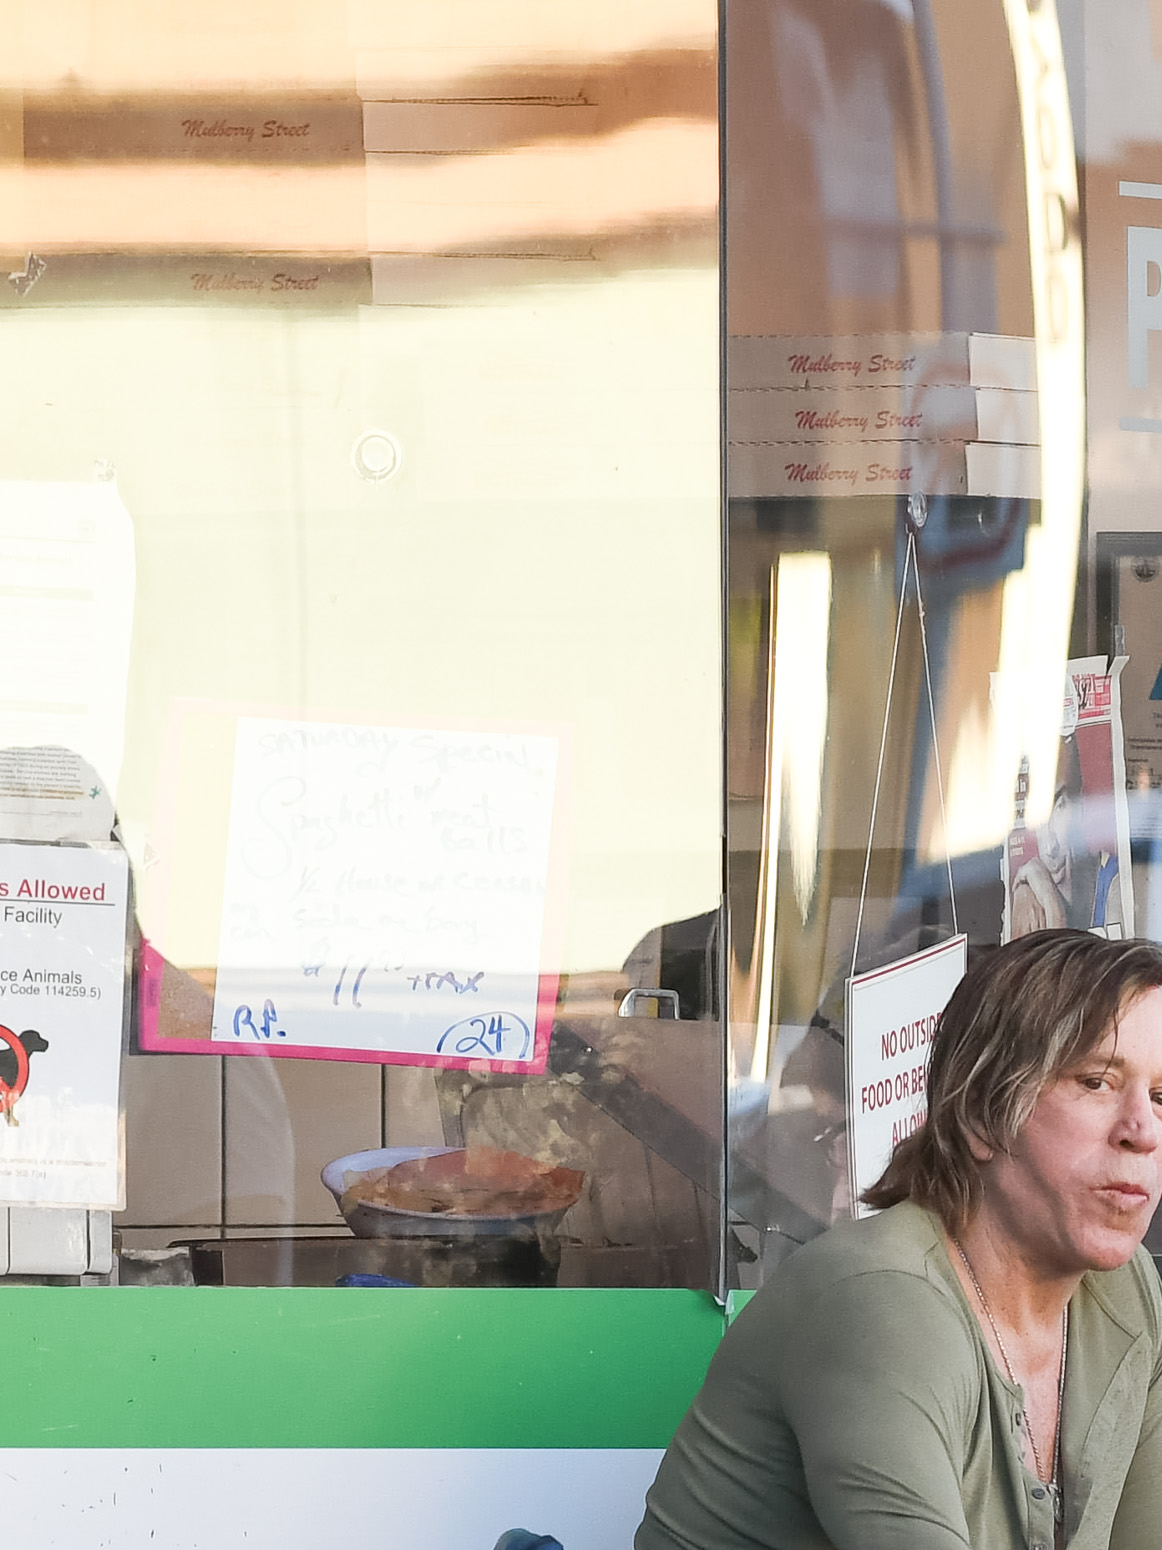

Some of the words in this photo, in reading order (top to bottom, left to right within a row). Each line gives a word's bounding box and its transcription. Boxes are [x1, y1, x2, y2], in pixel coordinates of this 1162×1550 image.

[182, 119, 255, 142] Mulberry
[262, 120, 310, 138] Street
[271, 273, 319, 292] Street
[788, 354, 862, 377] Mulberry
[868, 354, 915, 373] Street
[795, 410, 869, 433] Mulberry
[875, 410, 923, 429] Street
[784, 462, 860, 486] Mulberry
[865, 463, 913, 482] Street
[17, 879, 105, 901] Allowed
[4, 905, 62, 929] Facility
[22, 968, 82, 985] Animals
[10, 983, 40, 995] Code
[45, 985, 102, 1000] 114259.5)
[881, 1030, 897, 1061] NO
[899, 1012, 943, 1054] OUTSID
[861, 1078, 893, 1114] FOOD
[894, 1071, 909, 1102] OR
[892, 1108, 928, 1148] ALLOW
